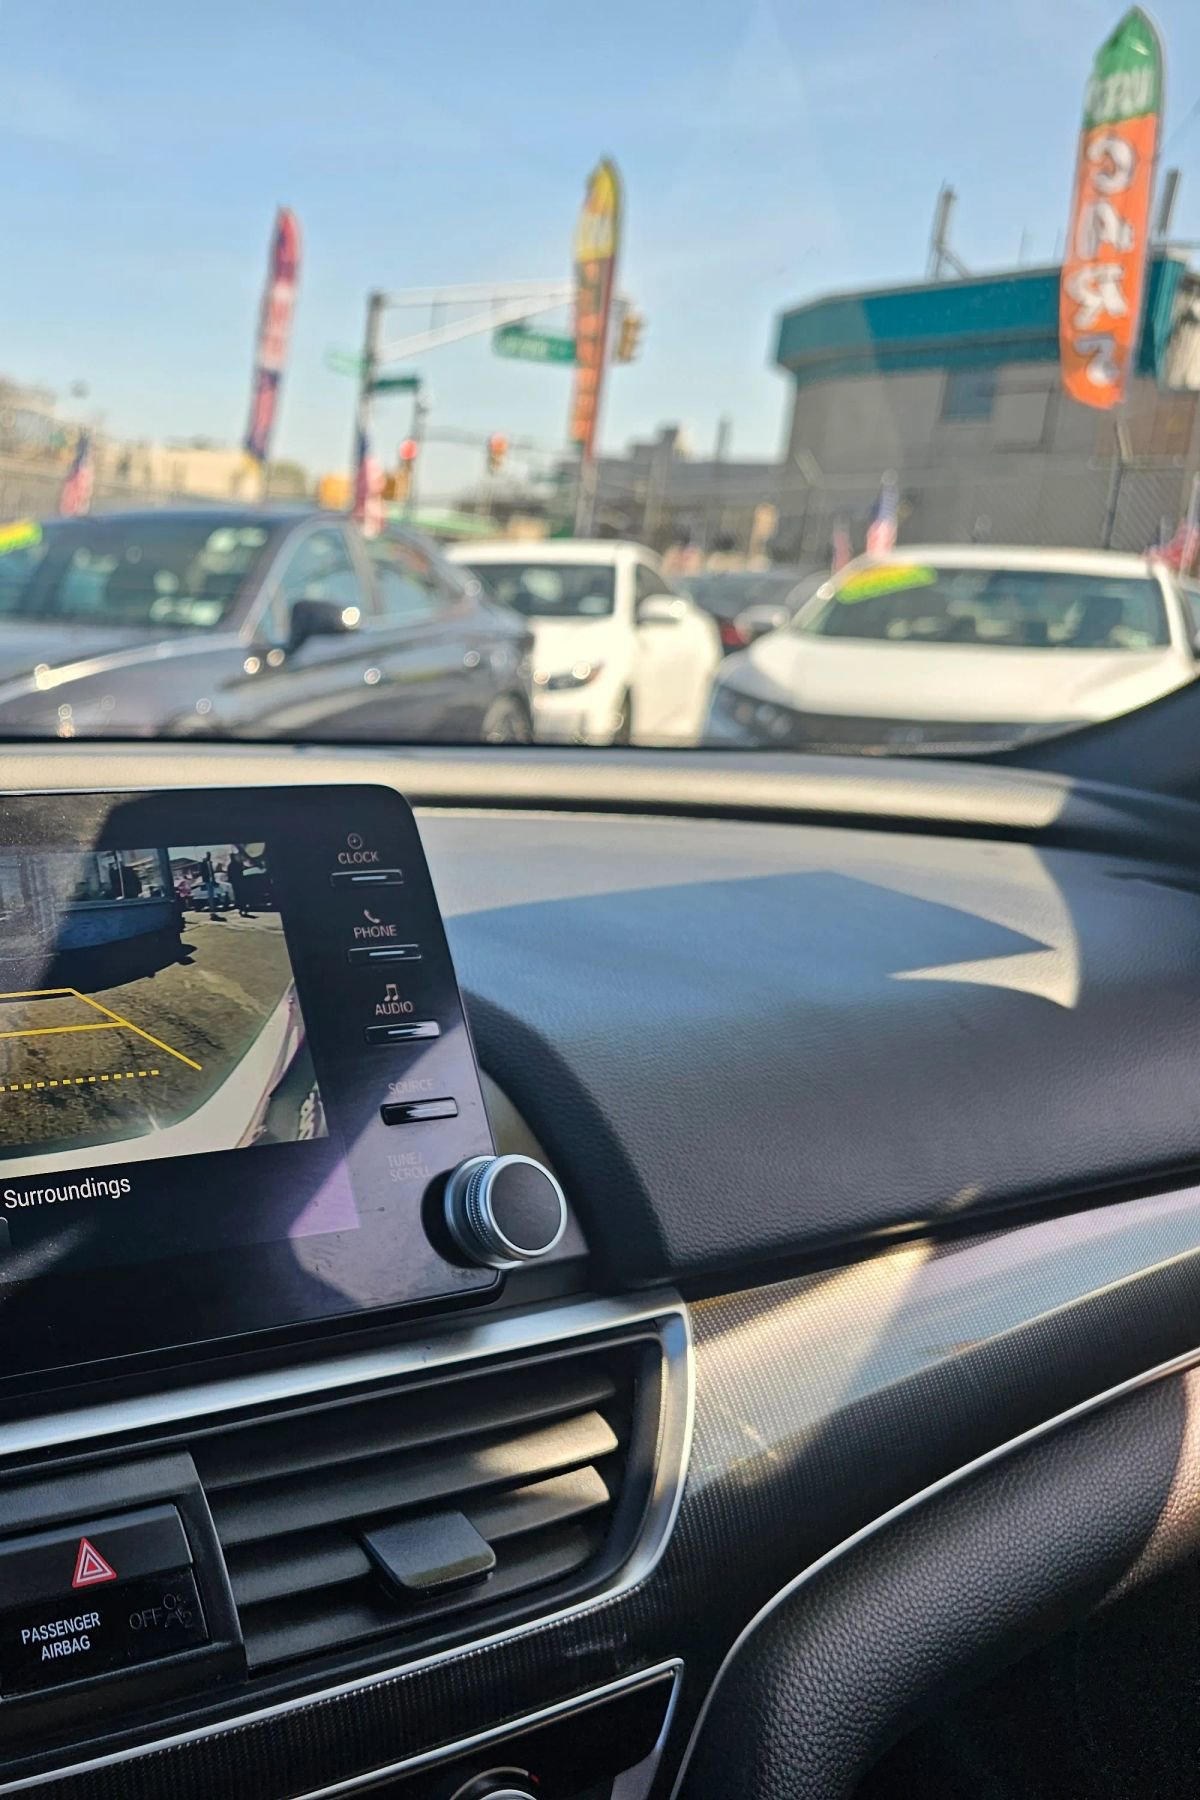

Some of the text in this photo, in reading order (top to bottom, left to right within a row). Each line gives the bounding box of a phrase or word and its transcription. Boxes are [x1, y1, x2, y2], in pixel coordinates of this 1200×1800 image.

[337, 850, 379, 864] CLOCK
[353, 924, 397, 939] PHONE
[375, 1001, 414, 1015] AUDIO
[387, 1079, 434, 1096] SOURCE
[3, 1177, 132, 1210] Surroundings
[20, 1611, 101, 1645] PASSENGER
[128, 1609, 164, 1630] OFF
[40, 1635, 91, 1662] AIRBAG
